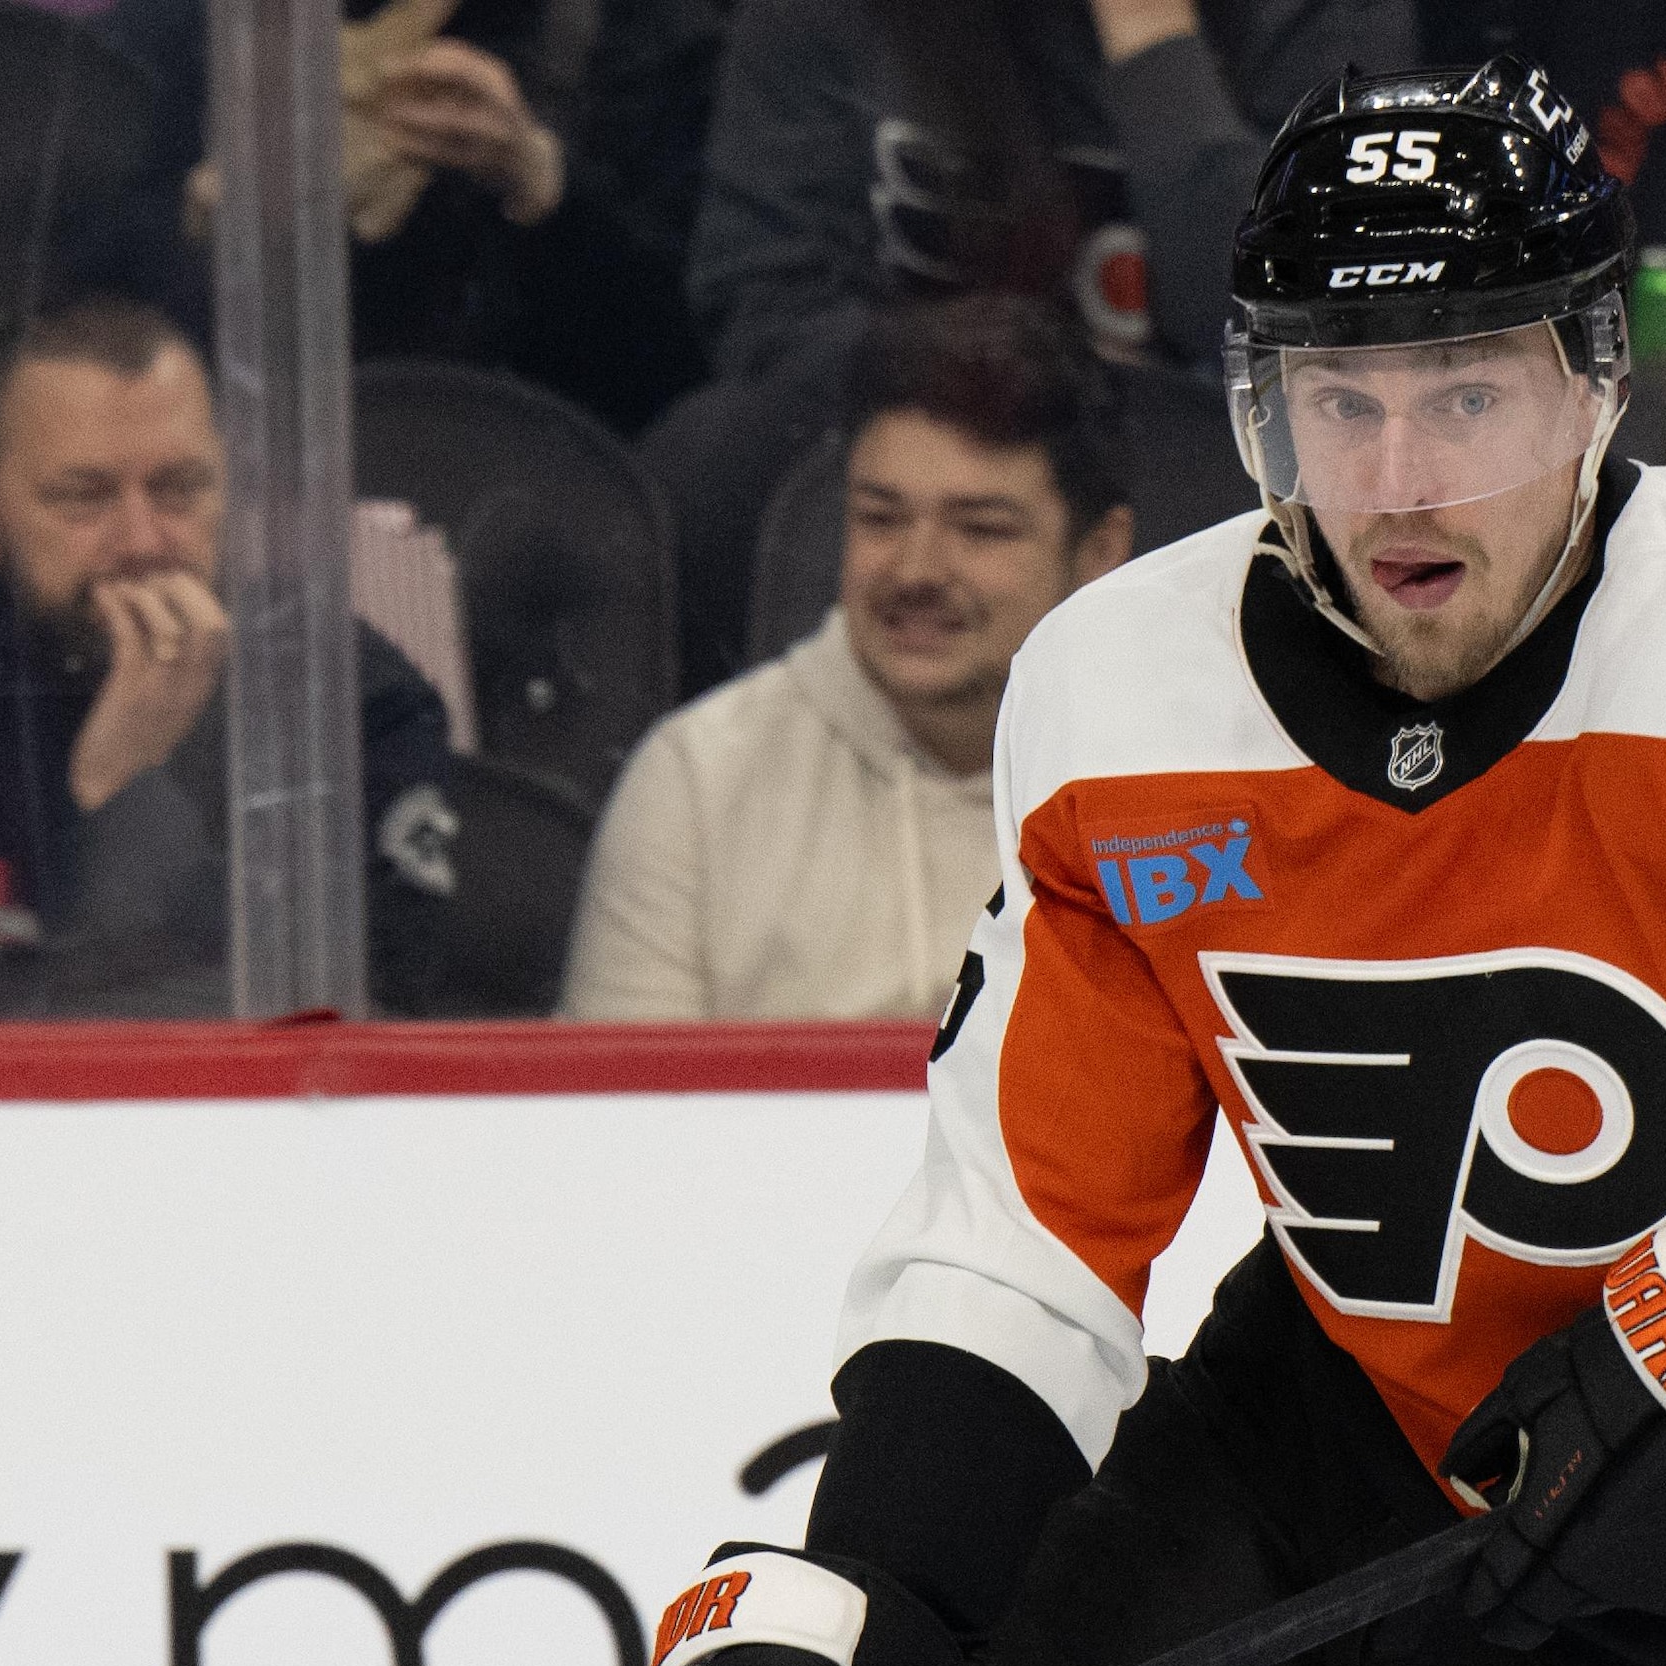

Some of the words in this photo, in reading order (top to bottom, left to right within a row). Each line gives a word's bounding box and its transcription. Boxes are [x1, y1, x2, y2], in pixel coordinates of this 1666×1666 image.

[1345, 131, 1441, 184] 55
[1328, 261, 1446, 288] CCM
[1399, 740, 1432, 777] NHL
[1096, 835, 1266, 928] IBX
